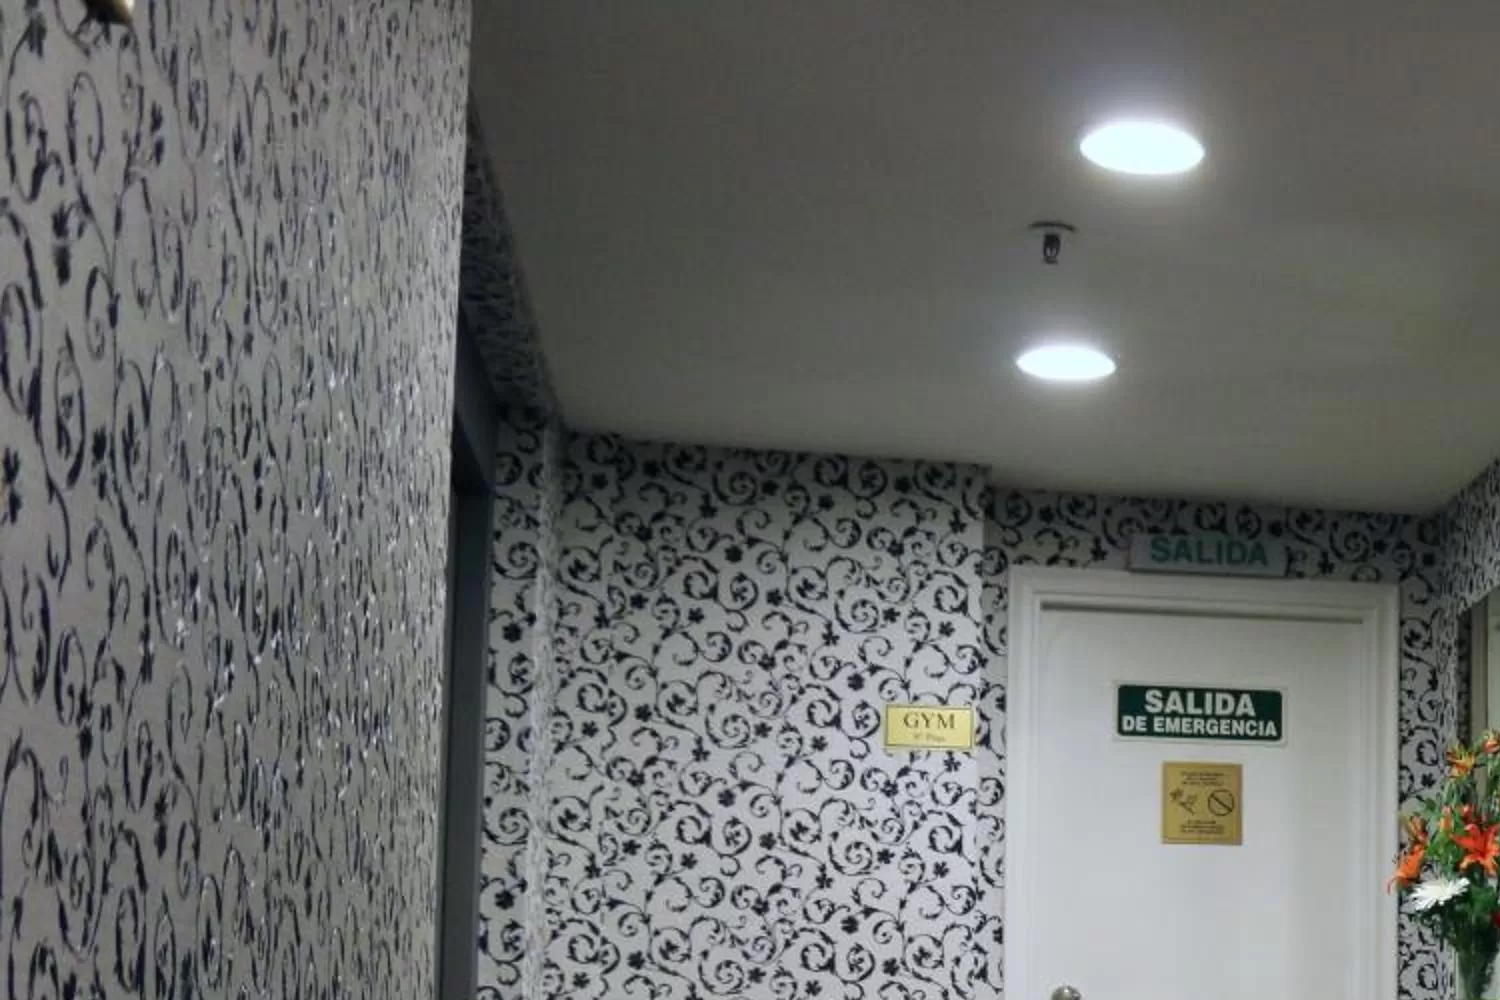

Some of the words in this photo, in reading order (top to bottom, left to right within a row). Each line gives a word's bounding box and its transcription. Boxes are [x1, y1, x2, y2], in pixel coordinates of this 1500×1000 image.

[1150, 536, 1268, 567] SALIDA
[1144, 688, 1255, 717] SALIDA
[903, 711, 955, 729] GYM
[1122, 714, 1149, 733] DE
[1153, 716, 1277, 737] EMERGENCIA
